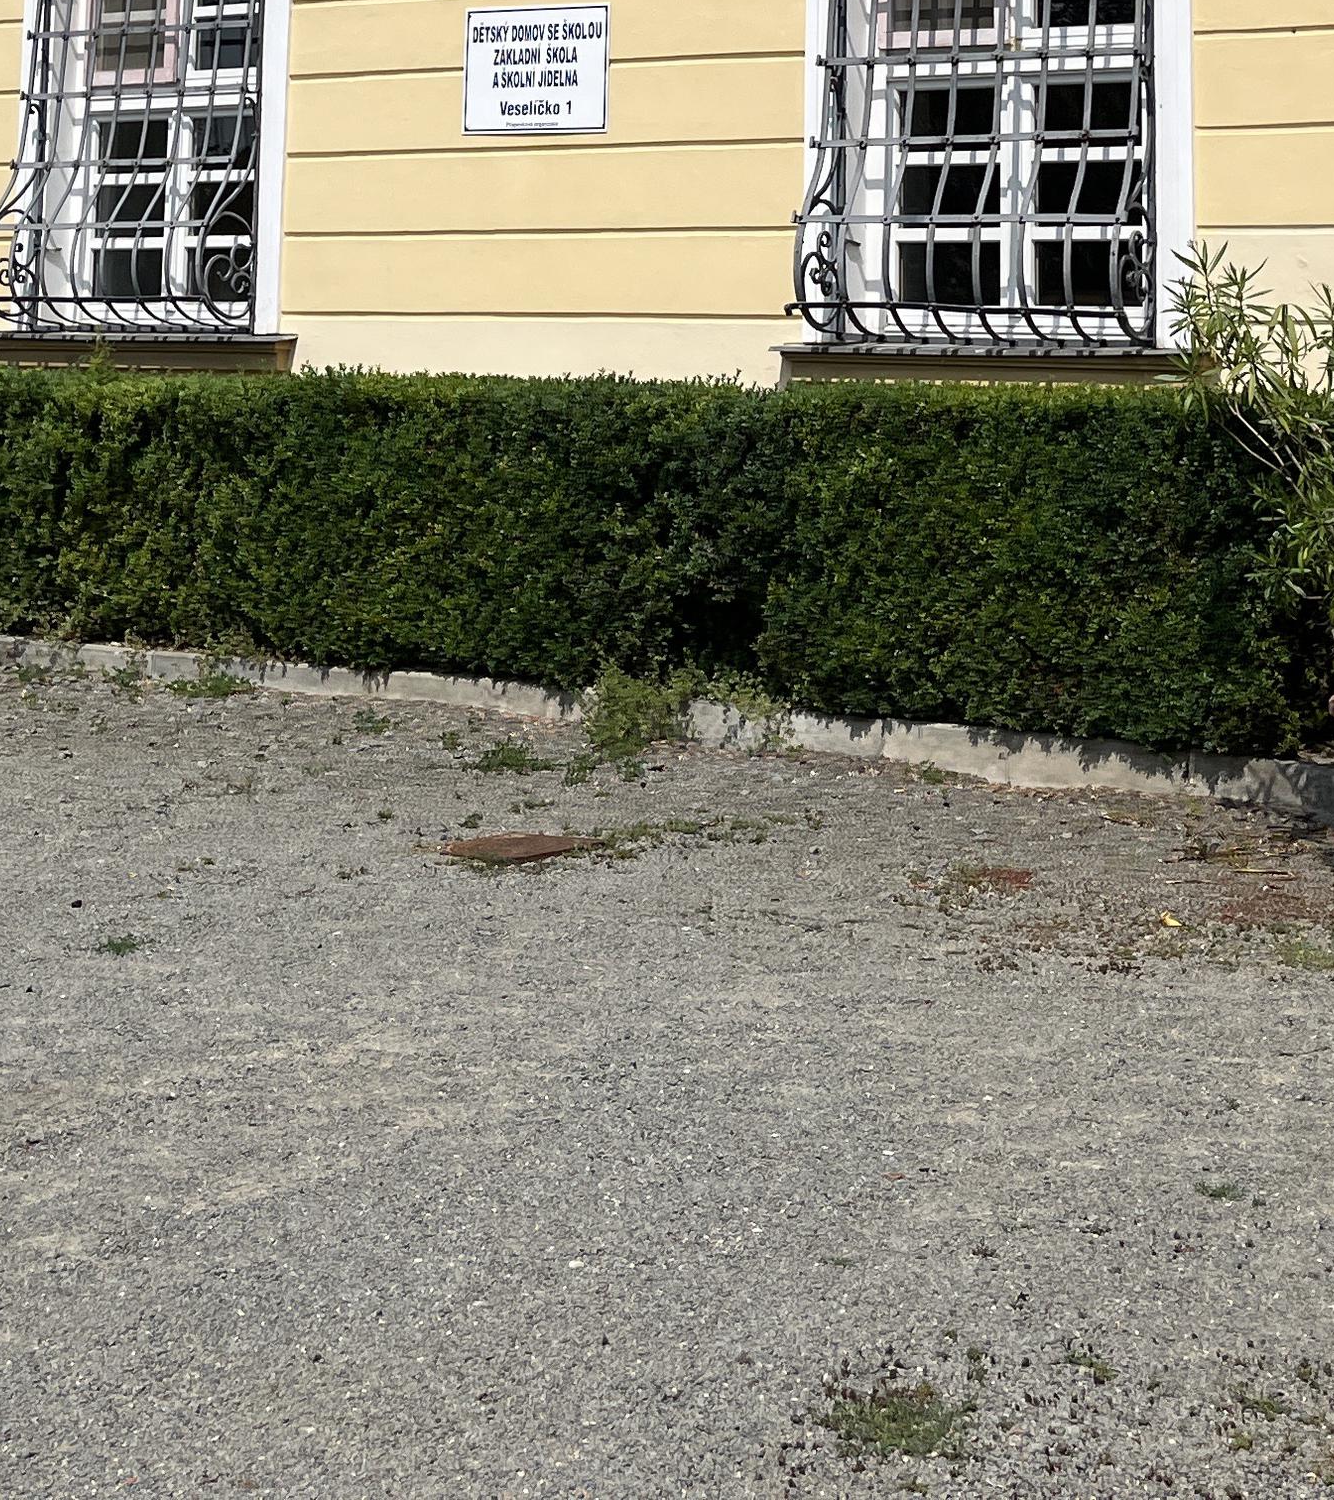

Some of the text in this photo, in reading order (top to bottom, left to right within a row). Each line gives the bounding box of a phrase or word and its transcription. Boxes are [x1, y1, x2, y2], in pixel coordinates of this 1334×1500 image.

[473, 19, 603, 43] DĚTSKÝ DOMOV SE ŠKOLOU
[494, 43, 578, 65] ZÁKLADNÍ ŠKOLA
[492, 66, 578, 88] A ŠKOLNÍ JÍDELNA
[500, 100, 572, 116] Veselíčko 1
